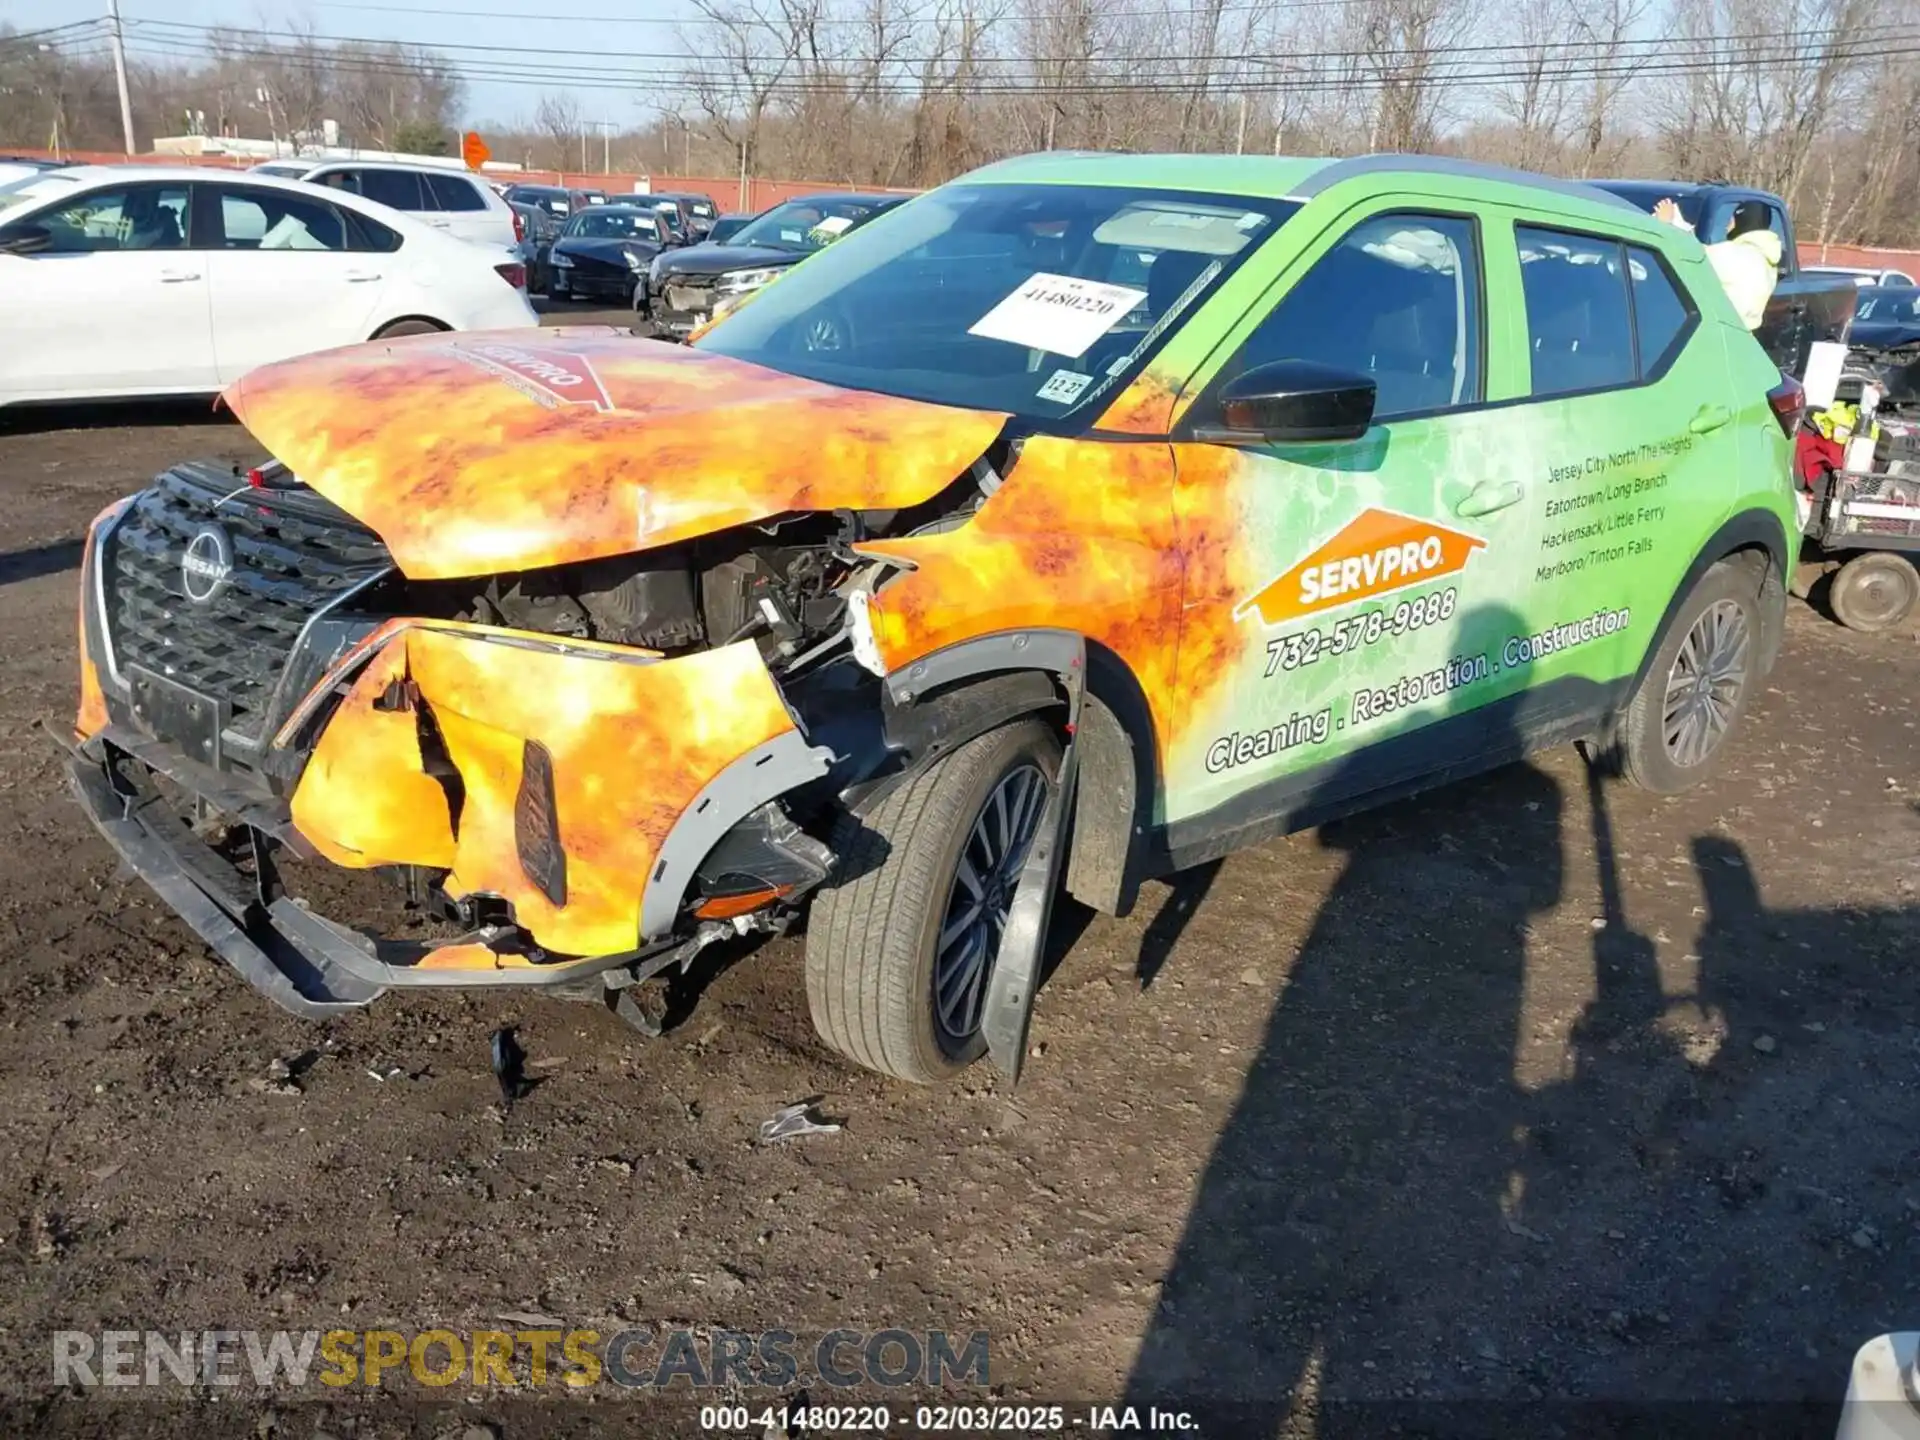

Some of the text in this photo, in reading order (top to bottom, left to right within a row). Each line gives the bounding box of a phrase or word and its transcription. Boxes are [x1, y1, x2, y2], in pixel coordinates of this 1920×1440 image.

[1024, 288, 1115, 315] 41480220
[1548, 463, 1583, 484] Jersey
[1586, 456, 1606, 475] City
[1659, 437, 1692, 456] Heights
[1634, 472, 1668, 494] Branch
[1637, 506, 1666, 523] Ferry
[1627, 537, 1653, 556] Falls
[1299, 535, 1443, 604] SERVPRO
[1264, 587, 1457, 677] 732-578-9888
[1205, 709, 1331, 774] Cleaning
[1351, 652, 1488, 725] Restoration
[1503, 606, 1631, 668] Construction
